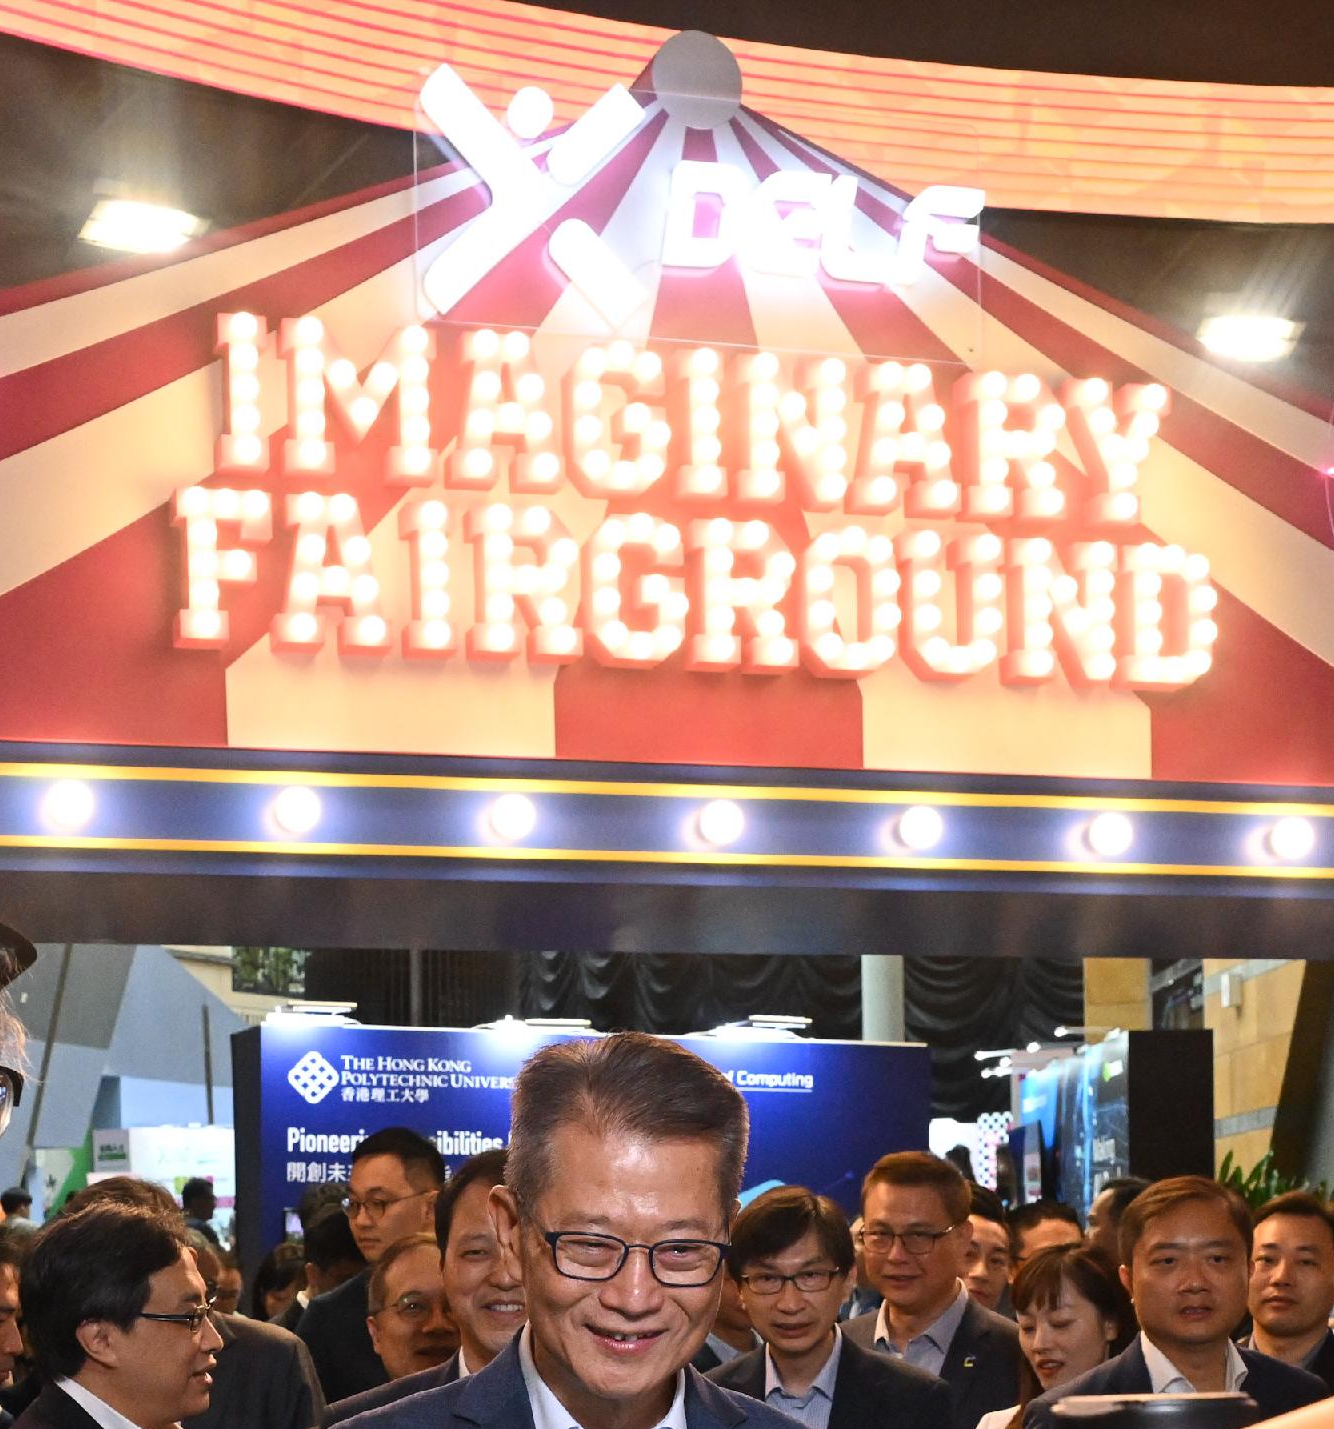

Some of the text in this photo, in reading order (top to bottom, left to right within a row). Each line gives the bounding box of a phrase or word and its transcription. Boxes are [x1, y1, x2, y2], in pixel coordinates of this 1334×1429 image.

[660, 160, 986, 286] DELF
[217, 311, 1171, 524] IMAGINARY
[173, 486, 1219, 692] FAIRGROUND
[340, 1054, 472, 1073] THE HONG KONG
[340, 1070, 449, 1088] POLYTECHNIC
[736, 1070, 814, 1088] Computing
[340, 1086, 430, 1104] 香港理工大學
[429, 1130, 504, 1156] ibilities
[286, 1161, 353, 1184] 開創未
